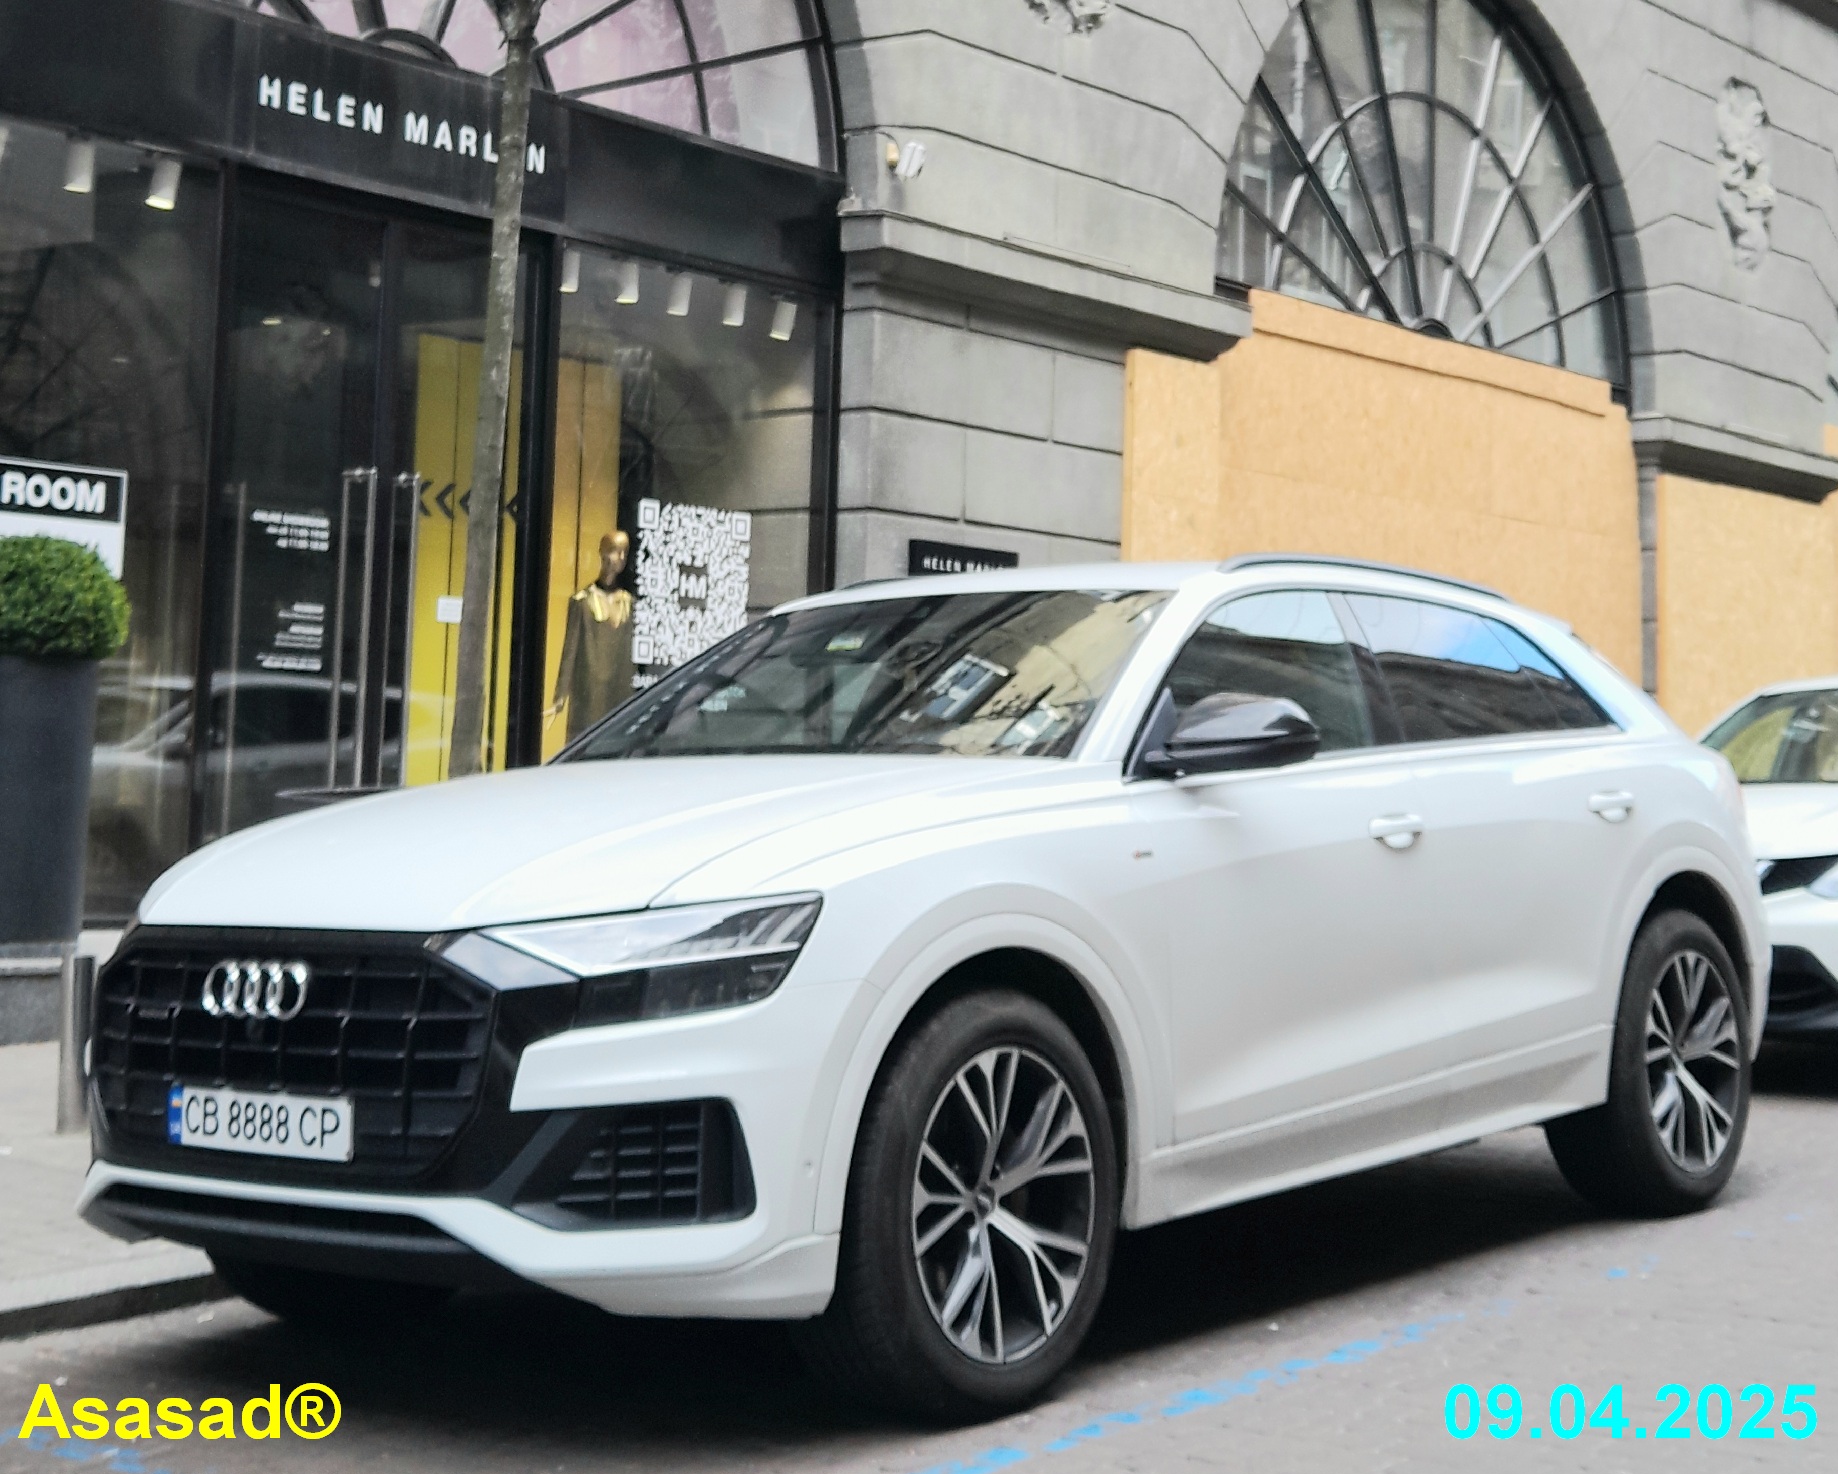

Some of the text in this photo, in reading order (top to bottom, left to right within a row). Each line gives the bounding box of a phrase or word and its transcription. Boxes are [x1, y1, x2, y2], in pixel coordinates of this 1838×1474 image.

[258, 74, 546, 174] HELEN MARLN
[1, 470, 107, 514] ROOM
[185, 1095, 340, 1149] CB 8888 CP
